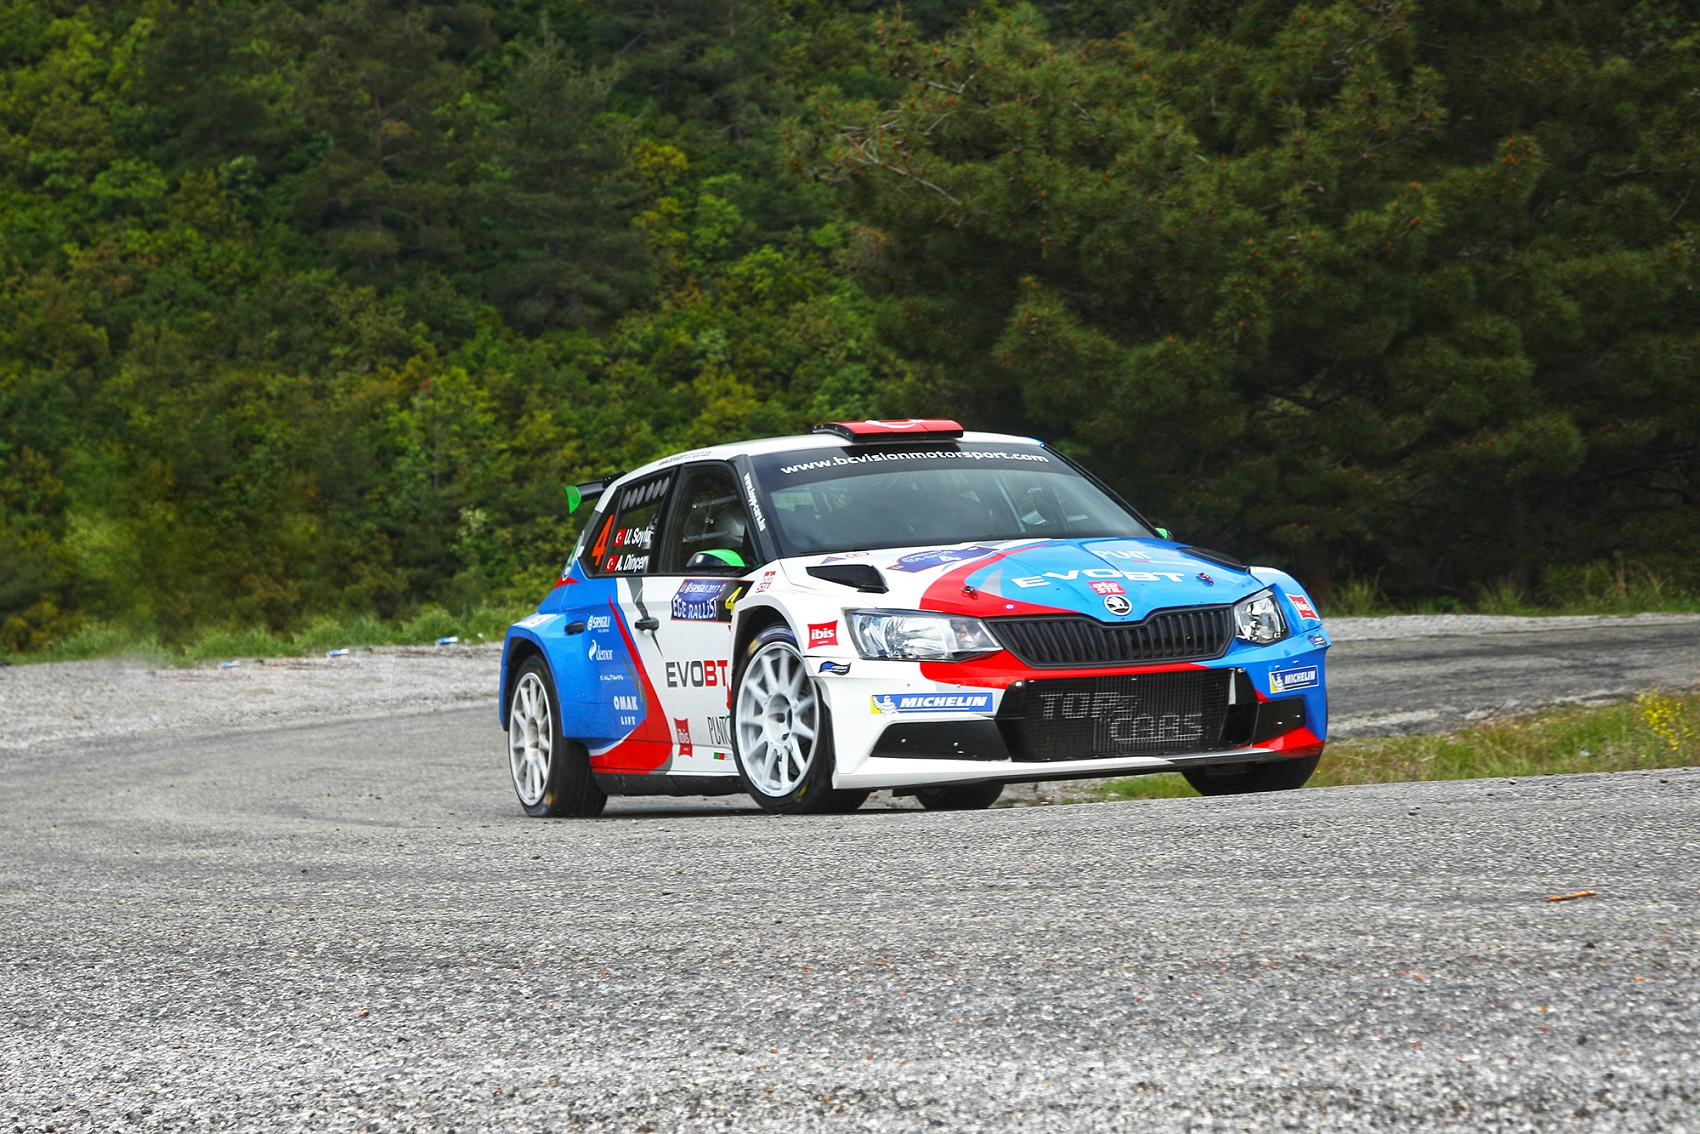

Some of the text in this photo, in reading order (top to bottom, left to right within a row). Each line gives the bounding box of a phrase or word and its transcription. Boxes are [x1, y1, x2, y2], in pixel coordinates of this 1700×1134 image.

[780, 450, 1049, 475] www.bcvisionmotorsport.com
[591, 514, 614, 567] 4
[1011, 568, 1185, 588] EVOBT
[673, 595, 687, 618] EGE
[725, 587, 743, 616] 4
[811, 628, 834, 640] ibis
[665, 659, 728, 688] EVOBT
[1284, 670, 1316, 685] MICHELIN
[613, 696, 638, 710] OMAK
[900, 696, 988, 708] MICHELIN
[620, 716, 636, 725] LIFT
